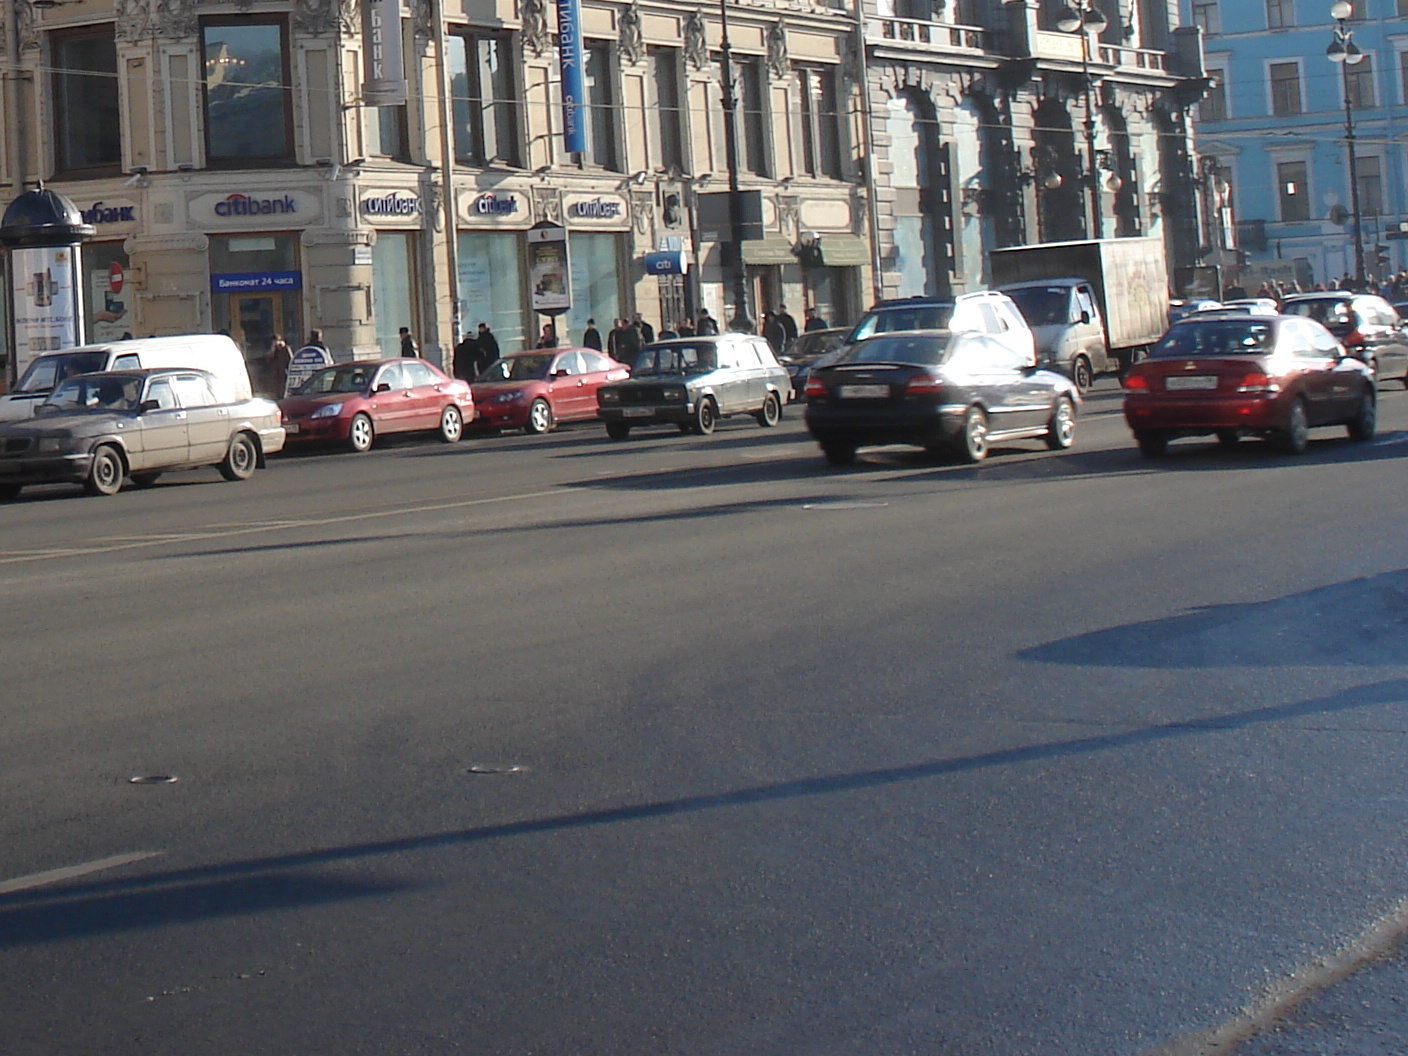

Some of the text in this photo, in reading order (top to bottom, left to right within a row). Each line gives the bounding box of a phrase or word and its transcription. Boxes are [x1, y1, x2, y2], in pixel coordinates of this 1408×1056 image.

[214, 193, 296, 216] citibank
[655, 259, 672, 270] citi
[219, 276, 294, 288] Банкомат 24 часа
